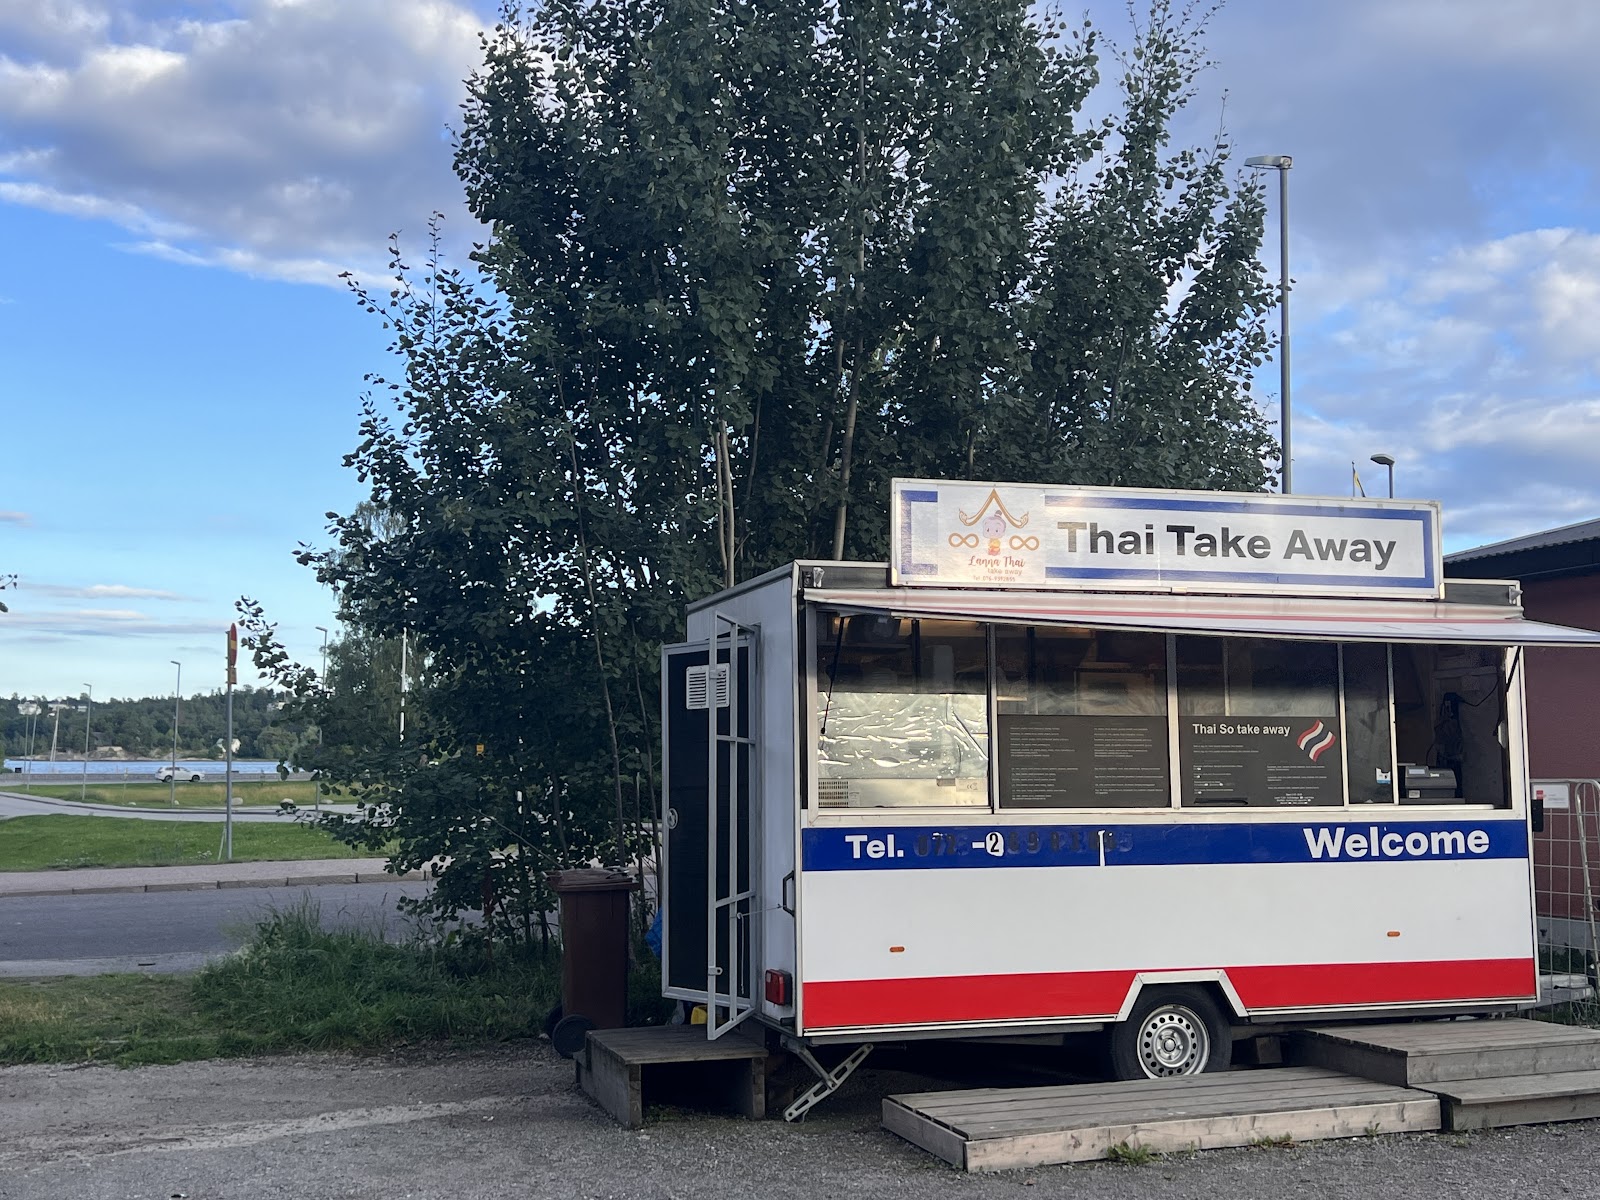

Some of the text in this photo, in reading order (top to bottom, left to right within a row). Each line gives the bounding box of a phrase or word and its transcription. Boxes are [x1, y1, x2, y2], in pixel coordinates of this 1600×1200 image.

[1057, 522, 1397, 571] Thai Take Away
[968, 555, 1025, 567] Lanna Thai
[1192, 723, 1291, 737] Thai So take away
[845, 834, 904, 859] Tel.
[1302, 826, 1490, 859] Welcome
